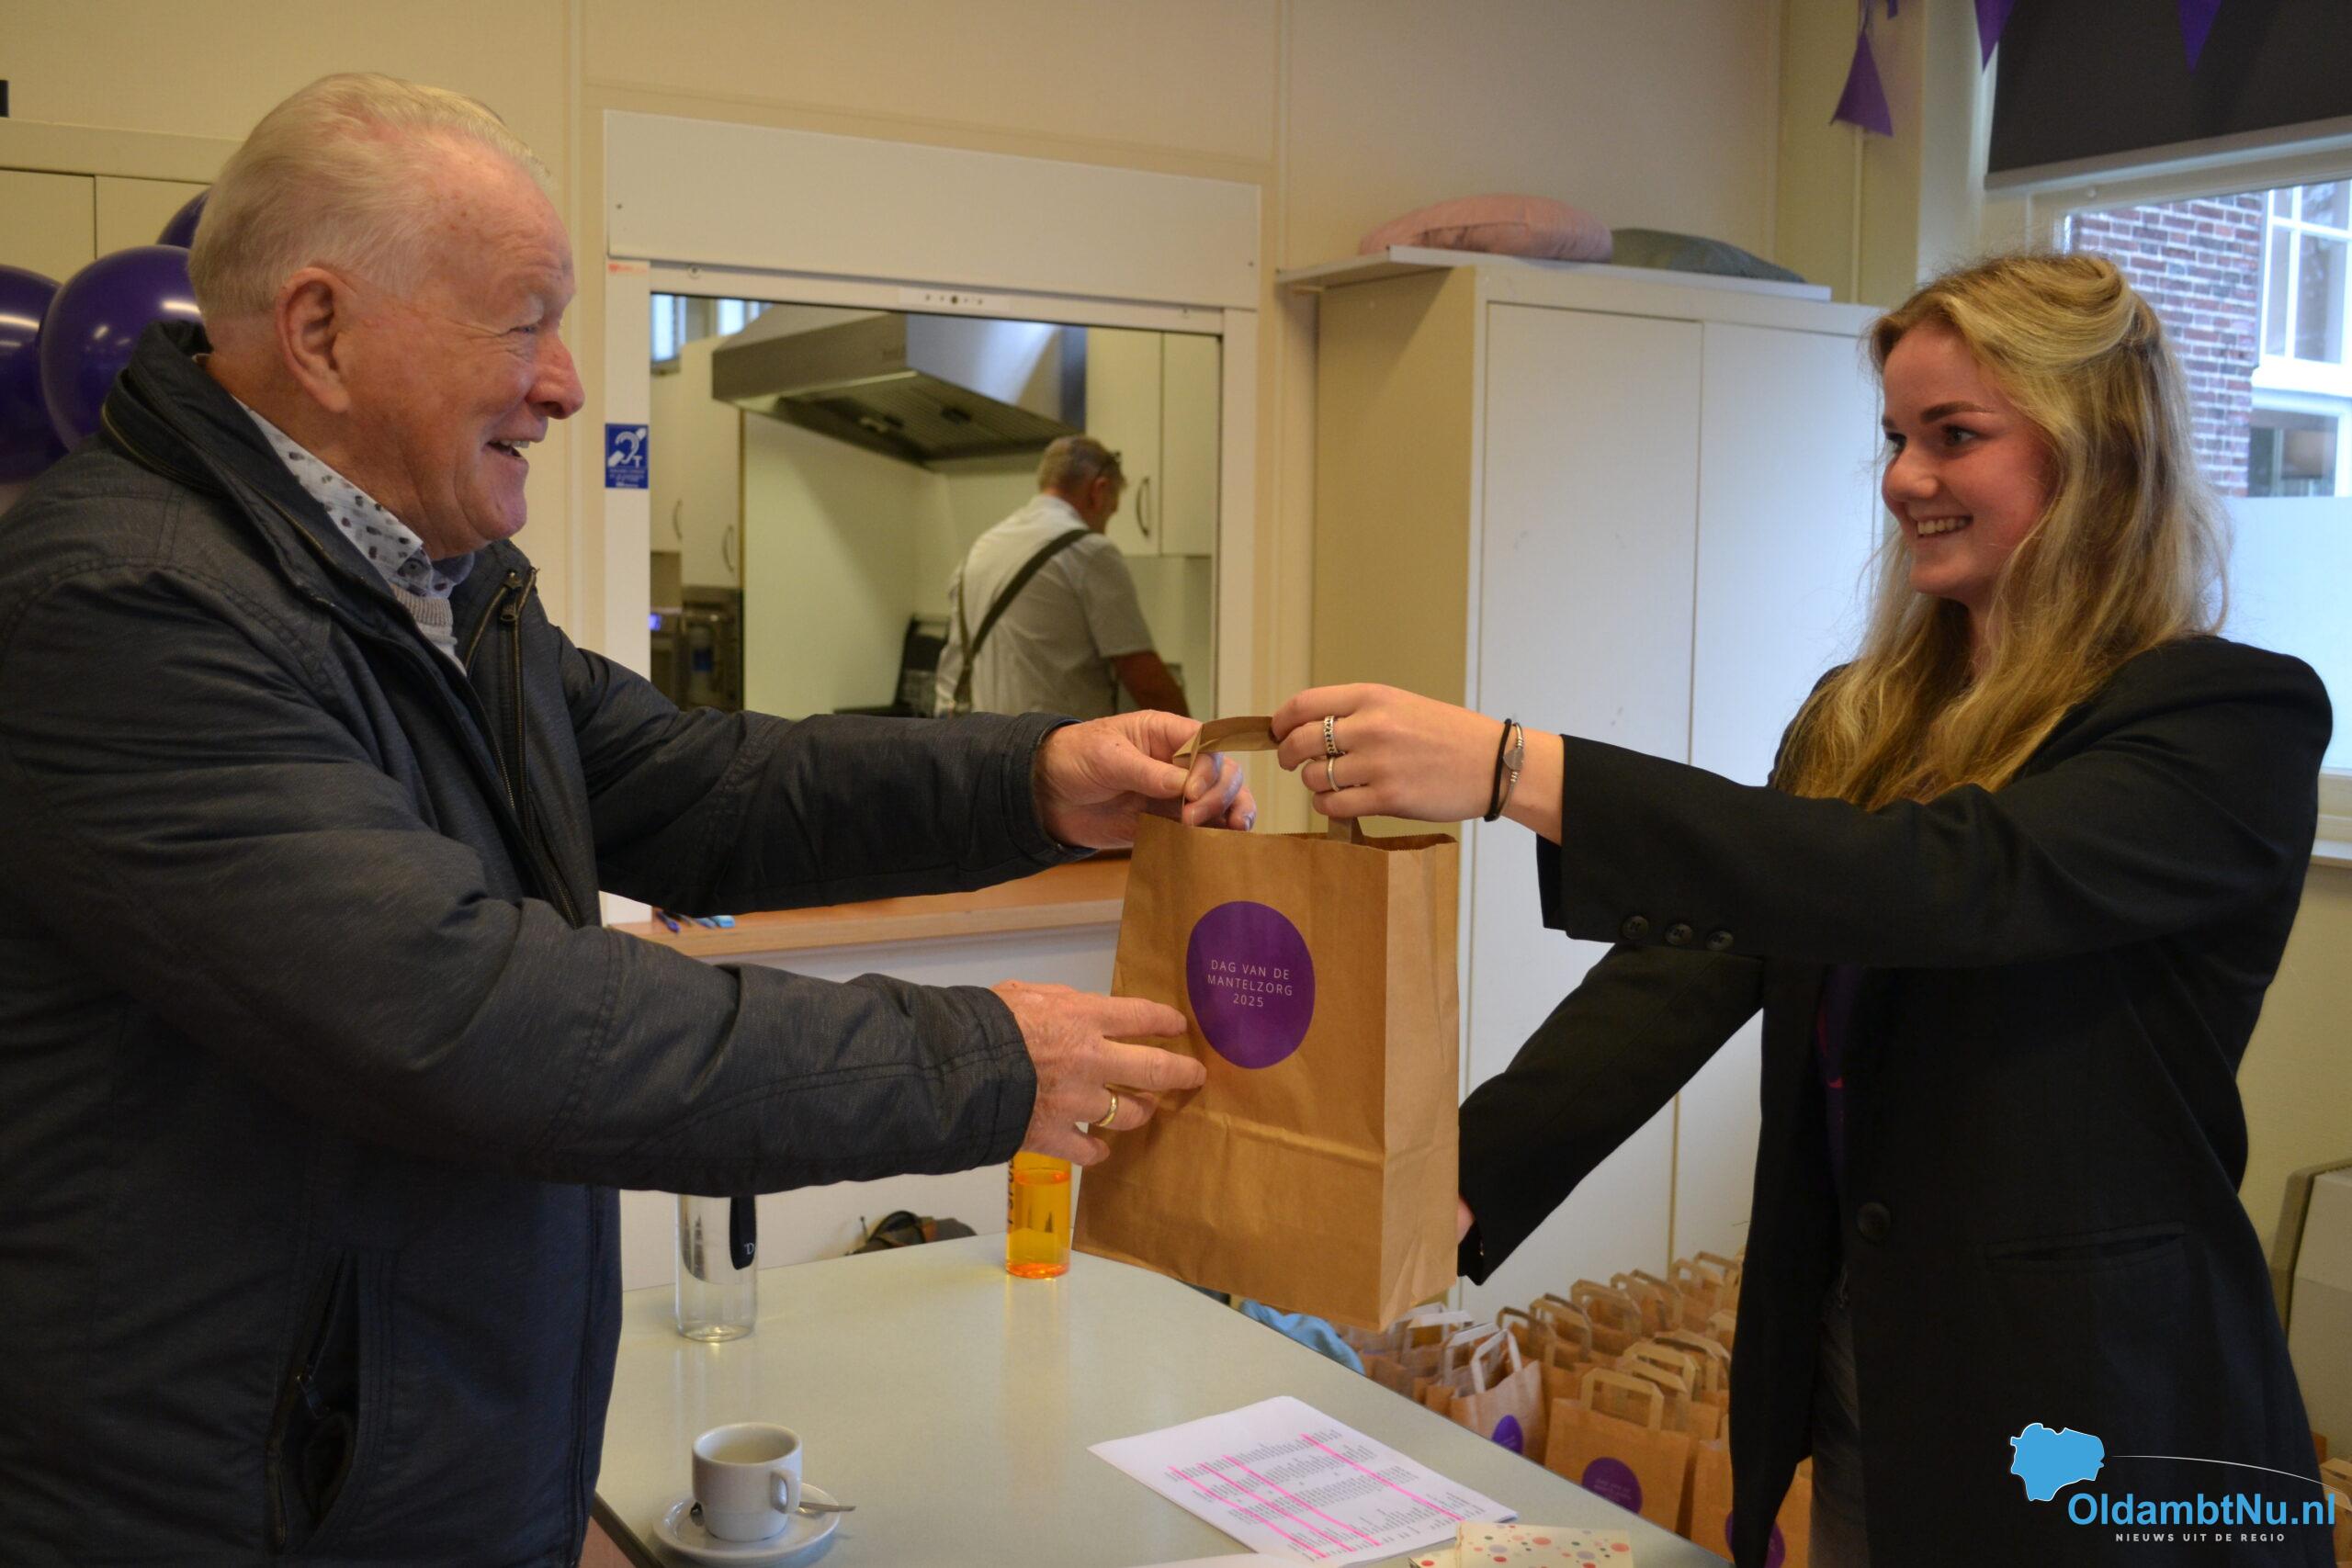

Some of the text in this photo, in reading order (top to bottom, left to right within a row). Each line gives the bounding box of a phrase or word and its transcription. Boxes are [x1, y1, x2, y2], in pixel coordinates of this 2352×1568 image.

[1211, 959, 1290, 980] DAG VAN DE
[1206, 974, 1294, 997] MANTELZORG
[1232, 993, 1264, 1008] 2025
